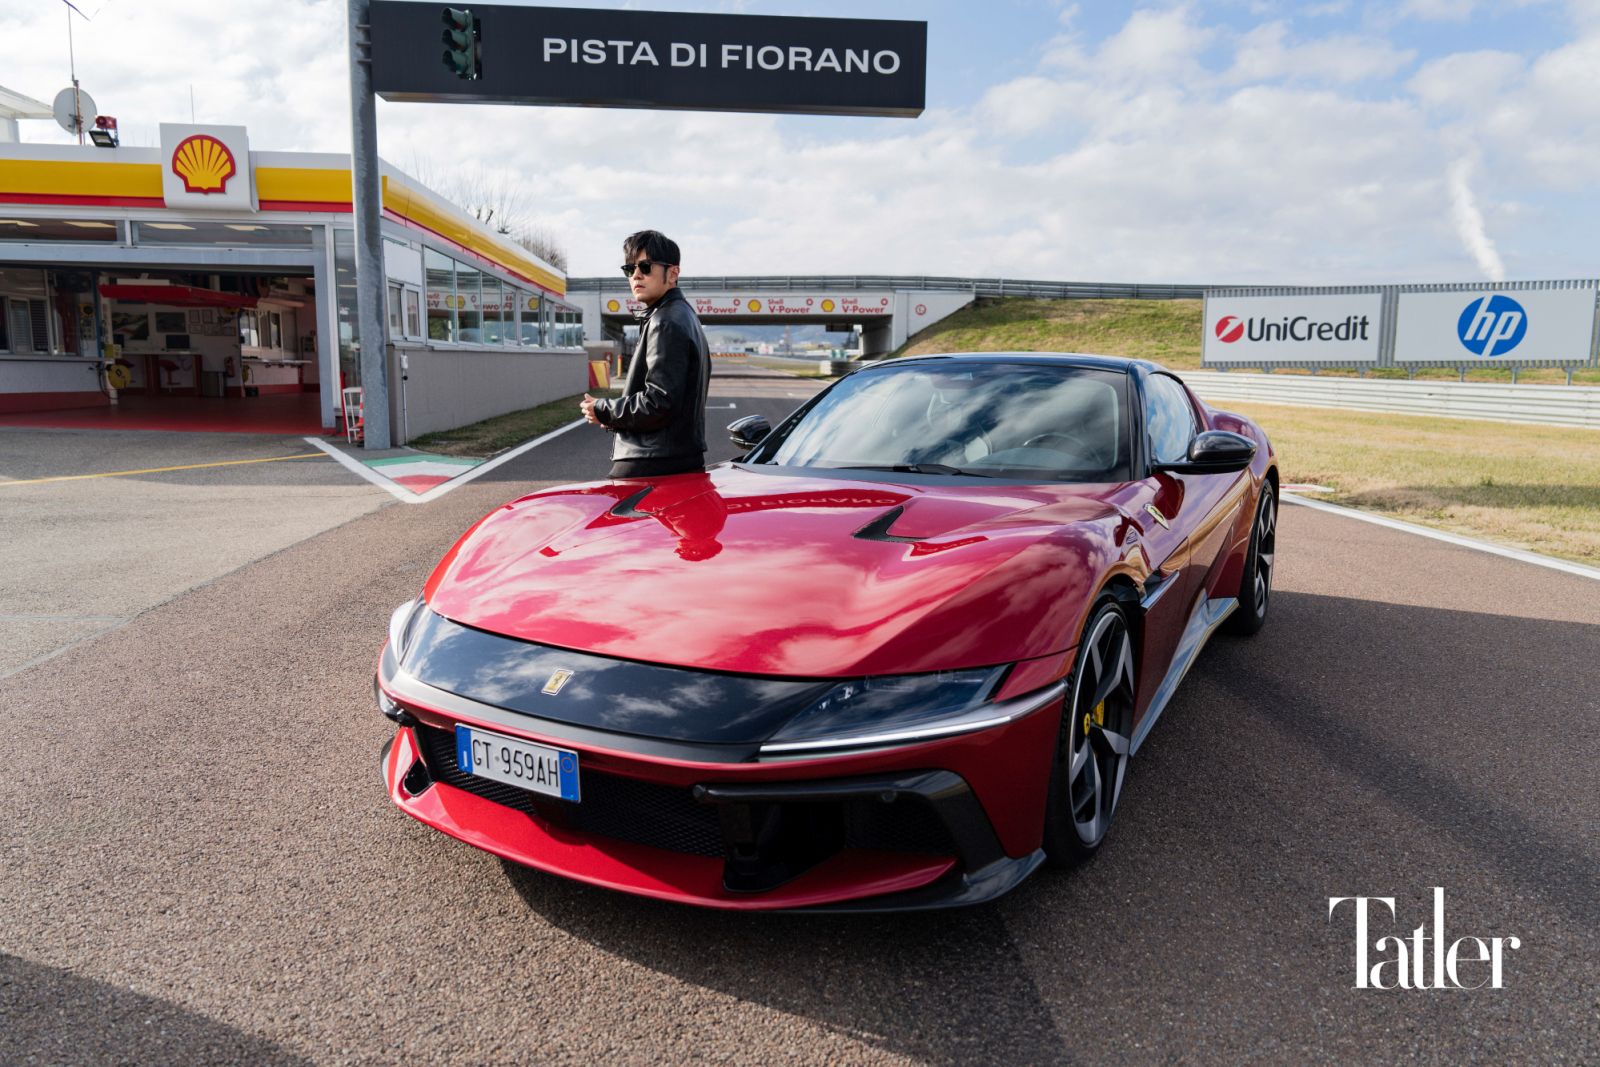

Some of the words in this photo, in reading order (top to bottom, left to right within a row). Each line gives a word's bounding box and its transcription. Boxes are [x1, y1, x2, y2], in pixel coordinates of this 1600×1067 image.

[542, 37, 660, 67] PISTA
[670, 42, 708, 69] DI
[720, 43, 902, 76] FIORANO
[696, 305, 739, 314] V-Power
[768, 305, 811, 314] V-Power
[841, 305, 885, 314] V-Power
[1246, 314, 1370, 343] UniCredit
[1463, 294, 1522, 357] hp
[472, 739, 491, 770] GT
[501, 747, 559, 788] 959AH
